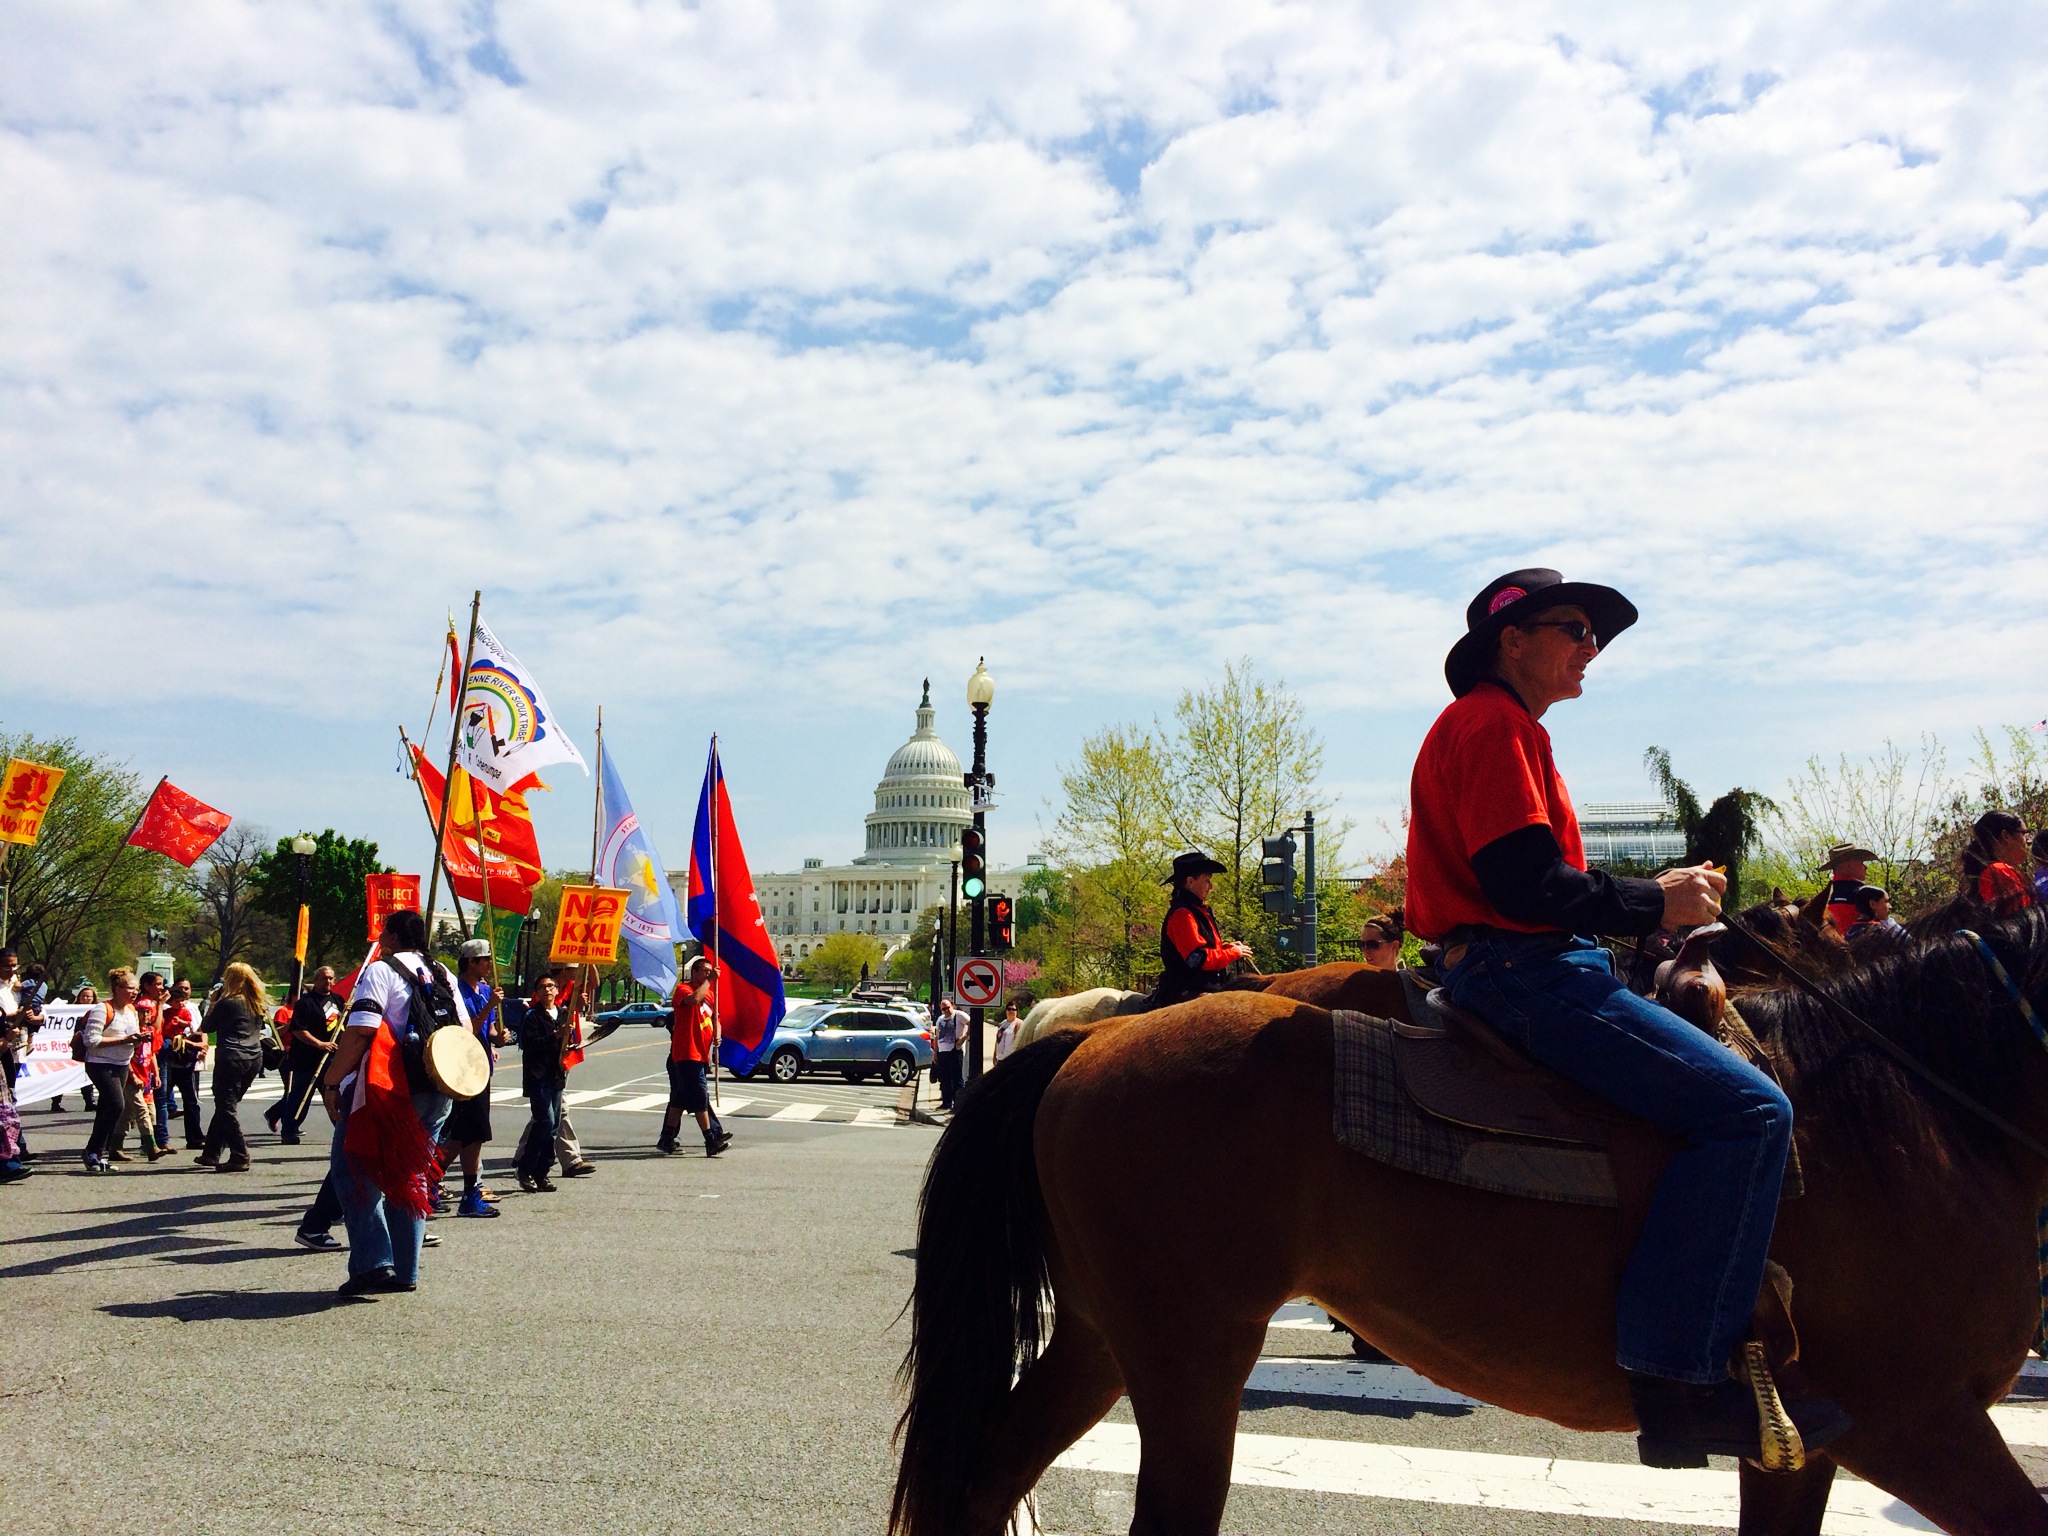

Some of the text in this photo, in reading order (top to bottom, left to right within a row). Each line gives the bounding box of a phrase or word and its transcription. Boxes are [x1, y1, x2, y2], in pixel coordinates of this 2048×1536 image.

[468, 674, 529, 741] ENNE RIVER SIOUX TRIBE
[17, 818, 37, 836] KXL
[378, 888, 413, 900] REJECT
[565, 893, 618, 920] NO
[560, 921, 612, 944] KXL
[1002, 928, 1010, 943] 4
[558, 944, 611, 957] PIPELINE
